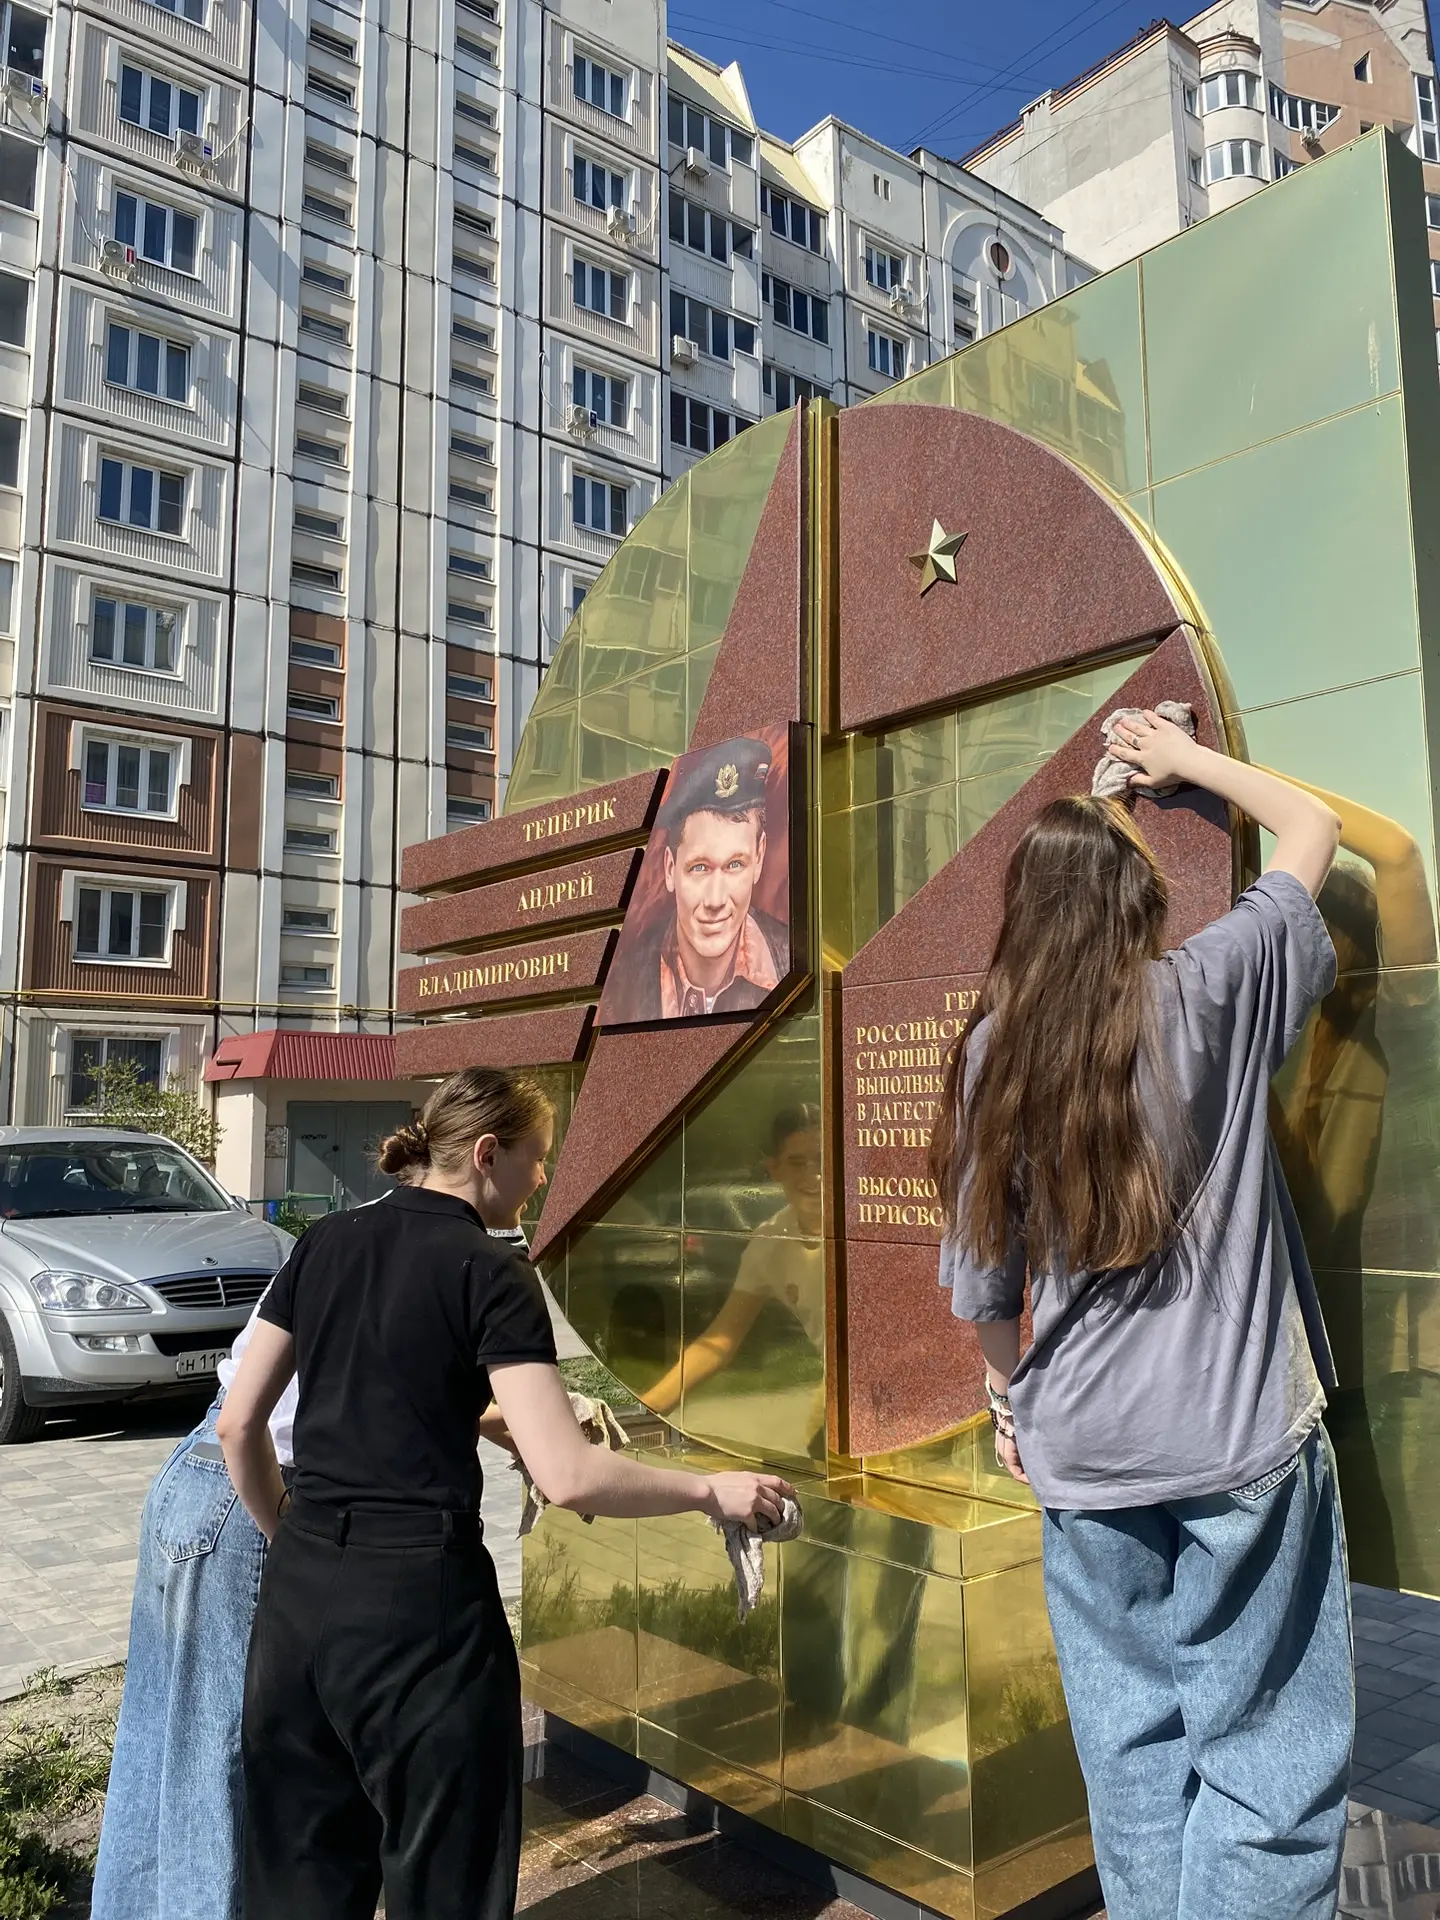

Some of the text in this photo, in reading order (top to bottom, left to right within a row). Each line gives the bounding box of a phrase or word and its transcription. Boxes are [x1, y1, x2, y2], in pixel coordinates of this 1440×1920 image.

[522, 797, 618, 843] ТЕПЕРИК
[516, 870, 595, 913] АНДРЕЙ
[418, 951, 570, 998] ВЛАДИМИРОВИЧ
[856, 1042, 941, 1070] СТАРШИЙ
[856, 1102, 867, 1121] В
